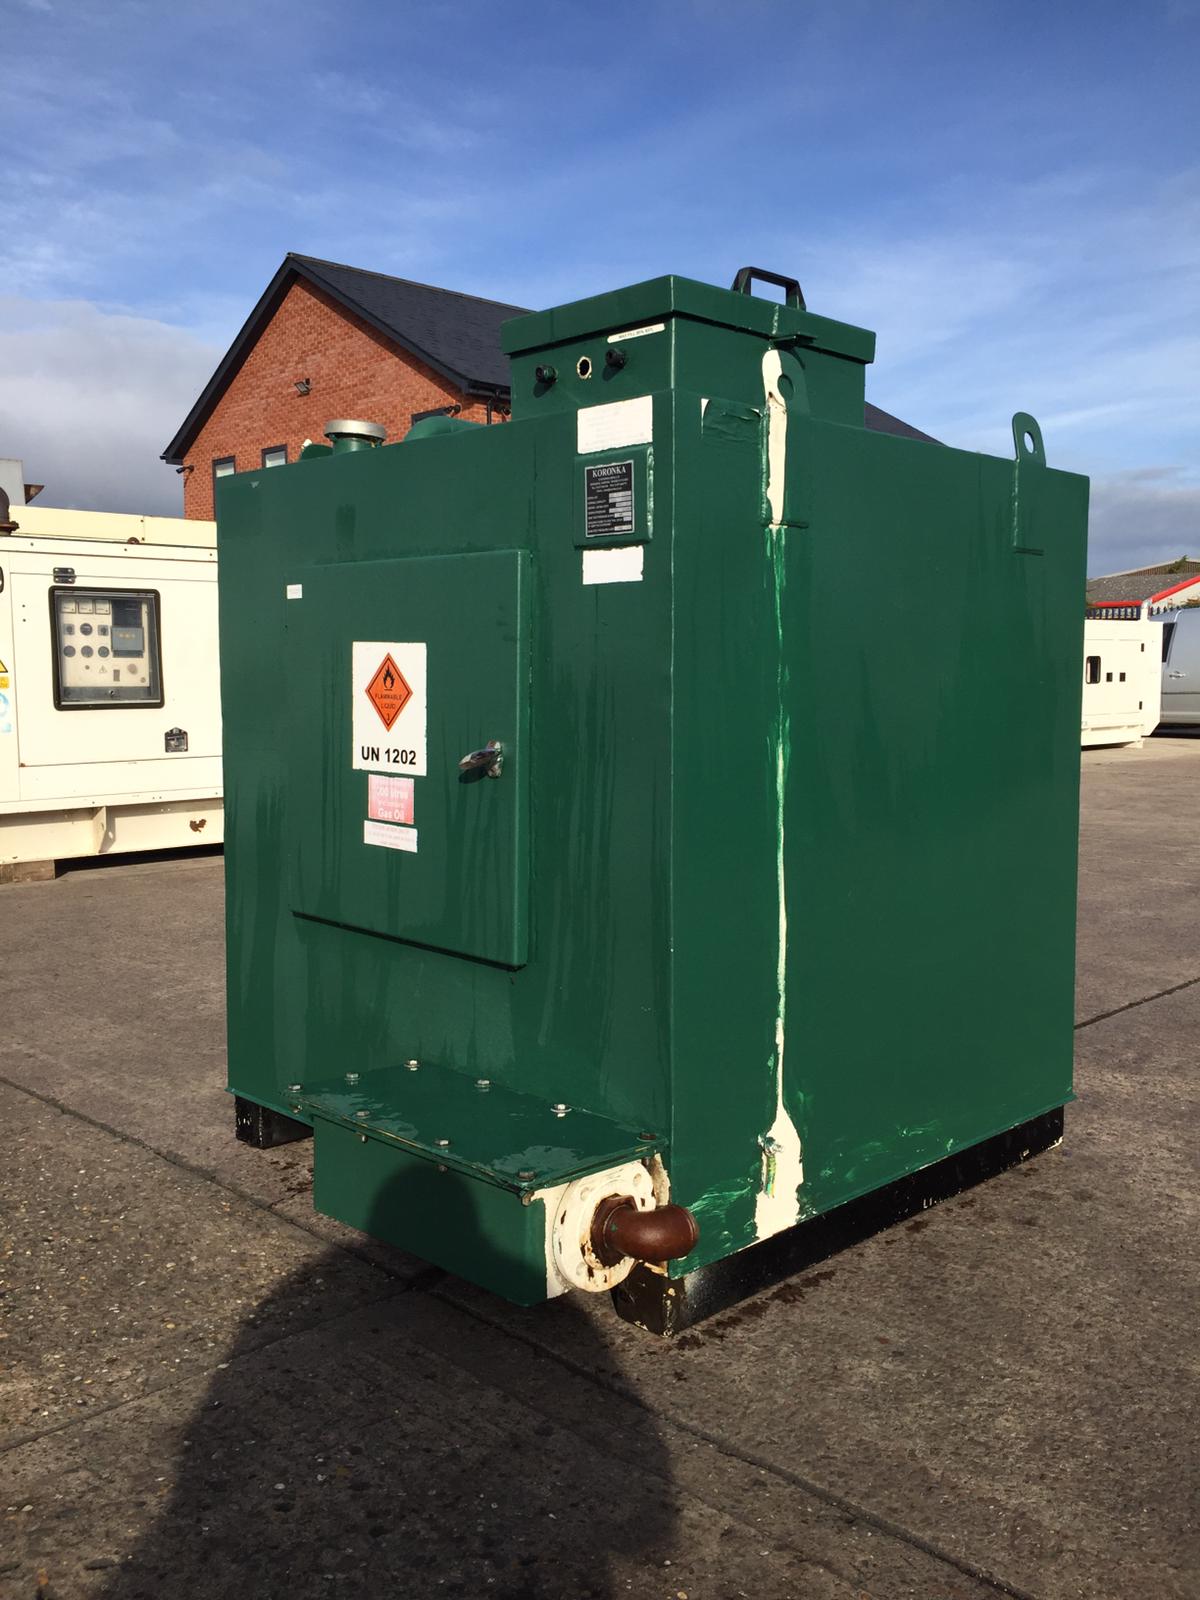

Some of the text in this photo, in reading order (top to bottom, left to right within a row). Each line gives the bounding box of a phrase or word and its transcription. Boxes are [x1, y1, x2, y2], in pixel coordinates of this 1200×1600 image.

[592, 466, 627, 478] KORONKA
[375, 693, 402, 701] FLAMMABLE
[361, 746, 417, 765] UN 1202
[377, 808, 405, 821] Gas Oil
